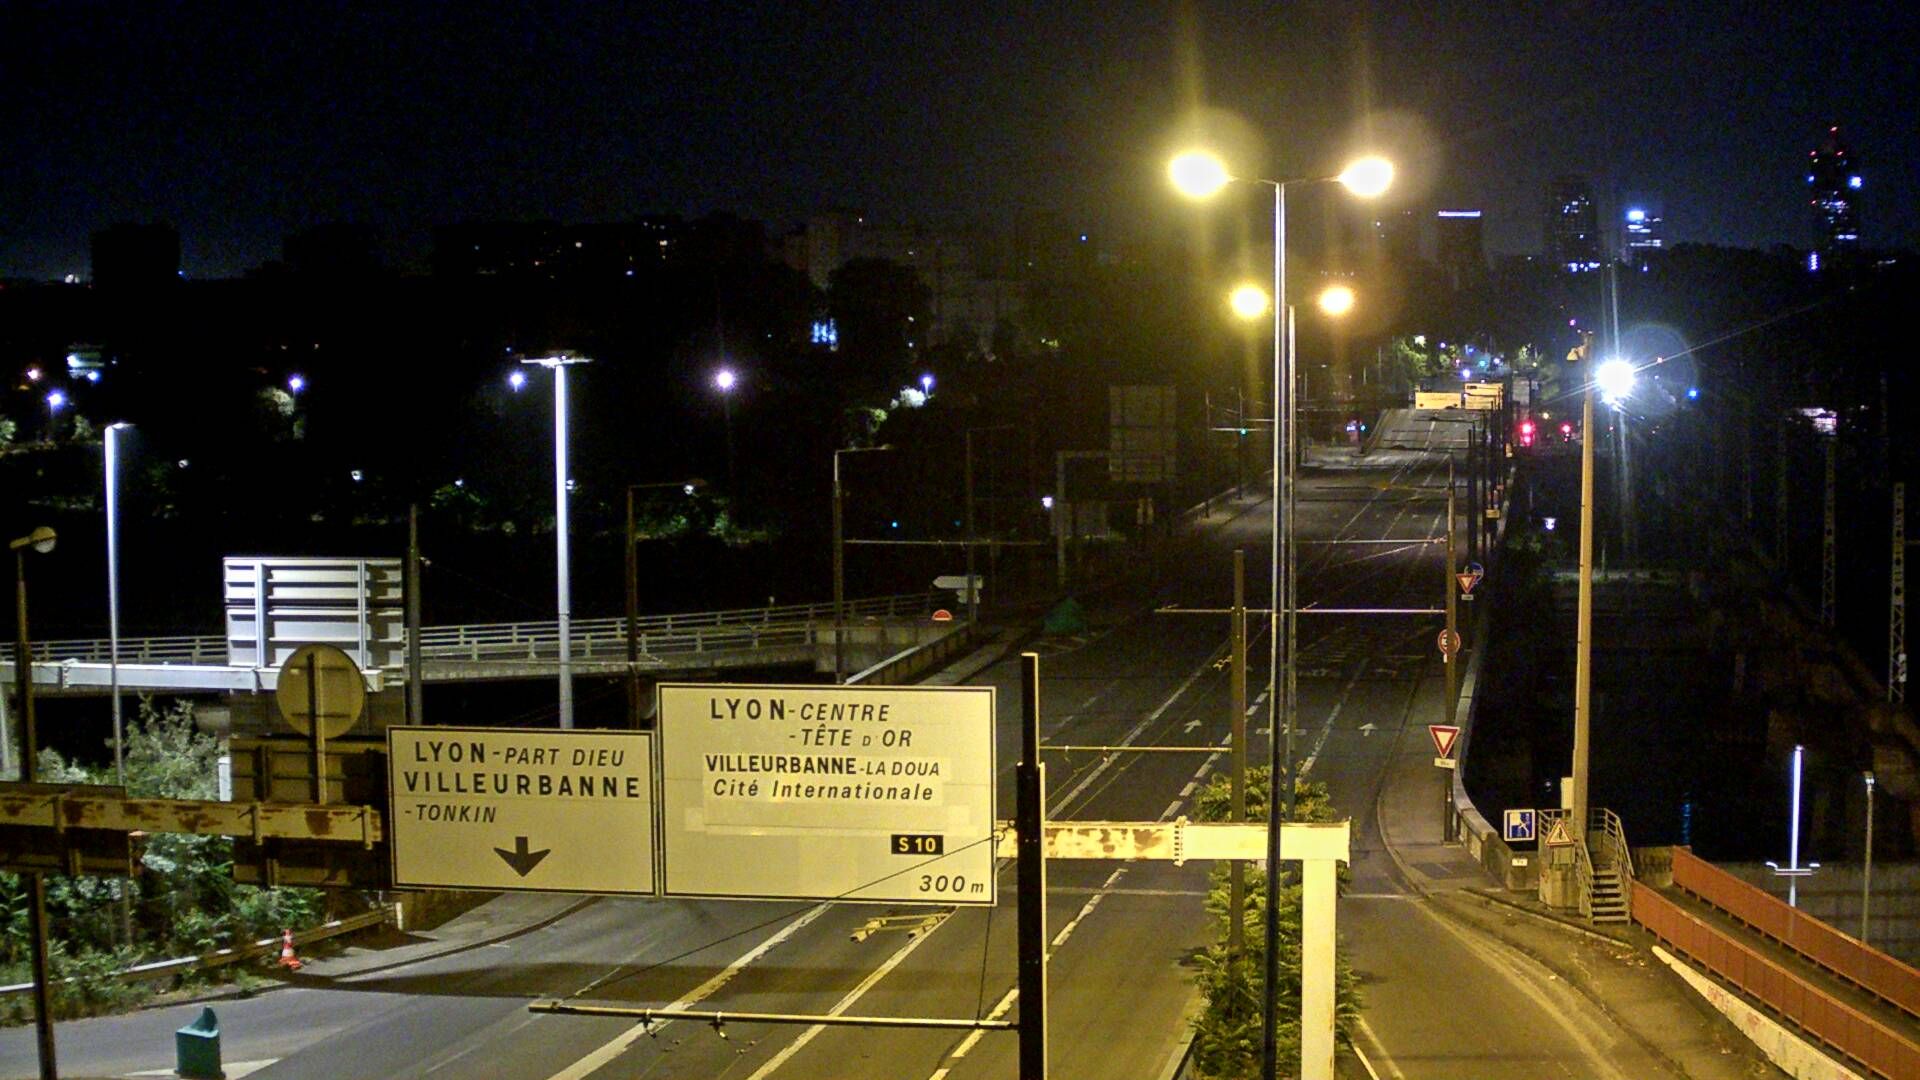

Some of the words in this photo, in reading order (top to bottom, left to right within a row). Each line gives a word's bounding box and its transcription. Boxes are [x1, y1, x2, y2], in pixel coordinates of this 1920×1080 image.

[572, 749, 625, 767] DIEU
[890, 761, 940, 777] DOUA
[403, 771, 640, 797] VILLEURBANNE
[713, 779, 759, 797] Cité
[772, 780, 933, 801] Internationale
[919, 875, 966, 893] 300
[970, 882, 984, 894] m
